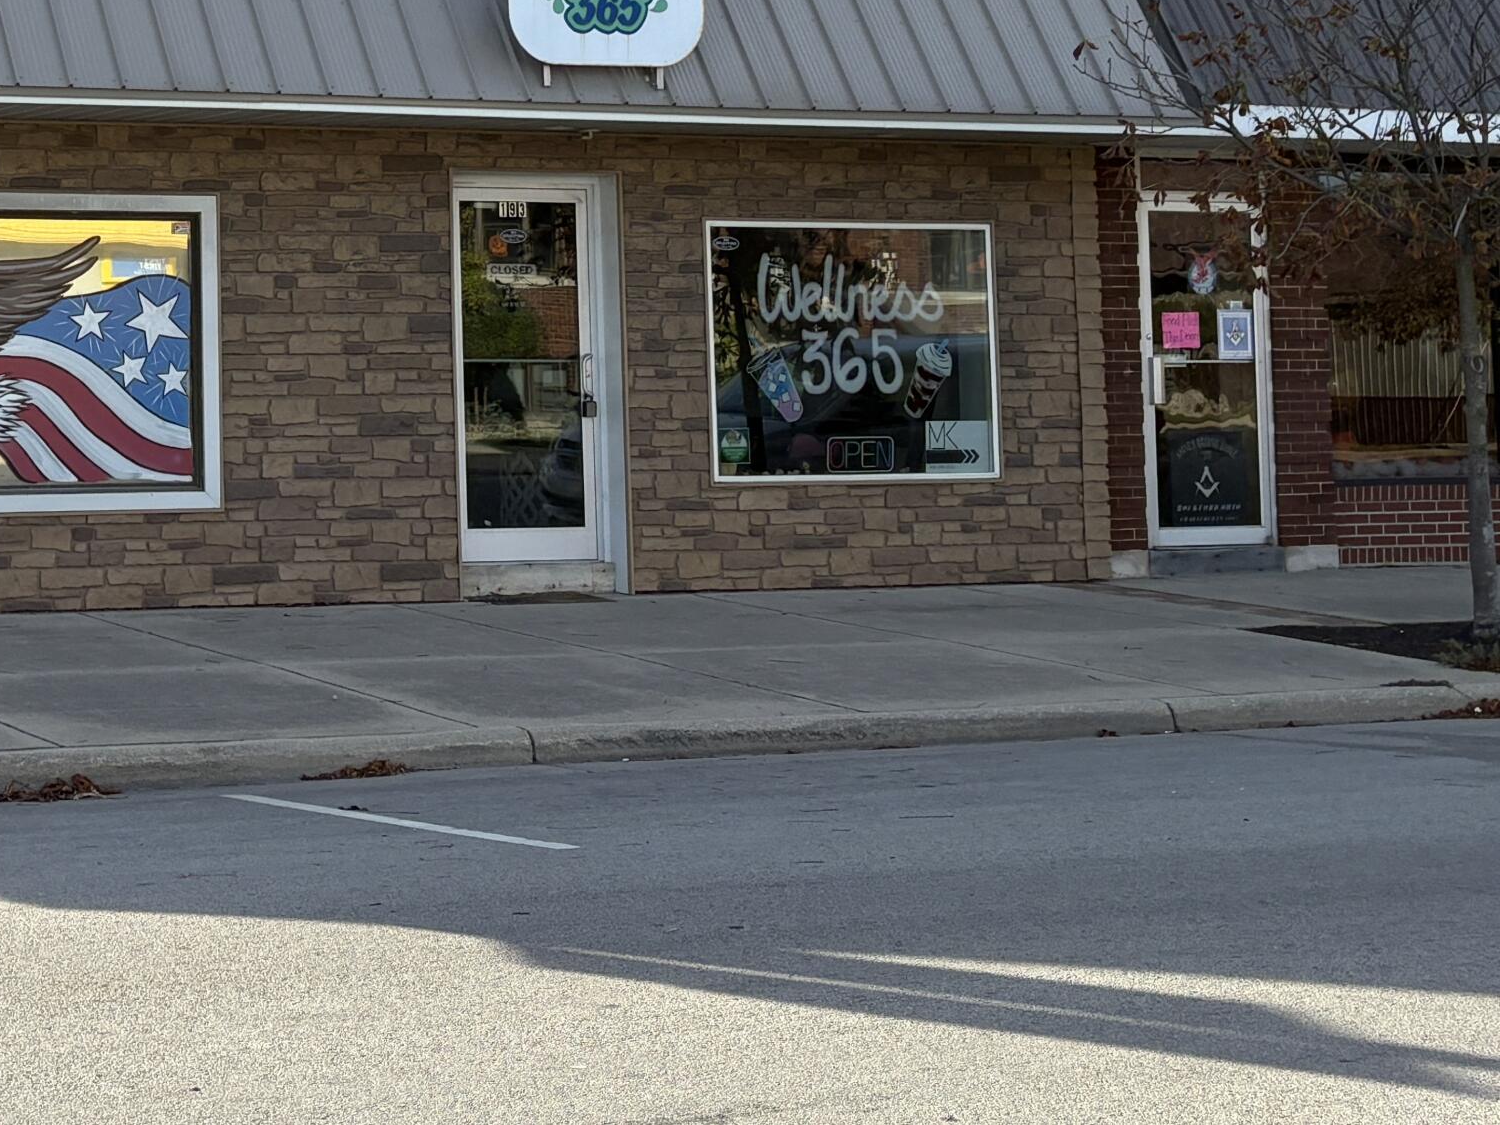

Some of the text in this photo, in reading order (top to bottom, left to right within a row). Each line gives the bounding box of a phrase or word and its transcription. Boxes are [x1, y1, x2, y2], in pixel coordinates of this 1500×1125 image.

[500, 202, 525, 217] 193
[490, 265, 533, 275] CLOSED
[757, 252, 945, 323] Wellness
[801, 327, 904, 395] 365
[829, 440, 892, 468] OPEN
